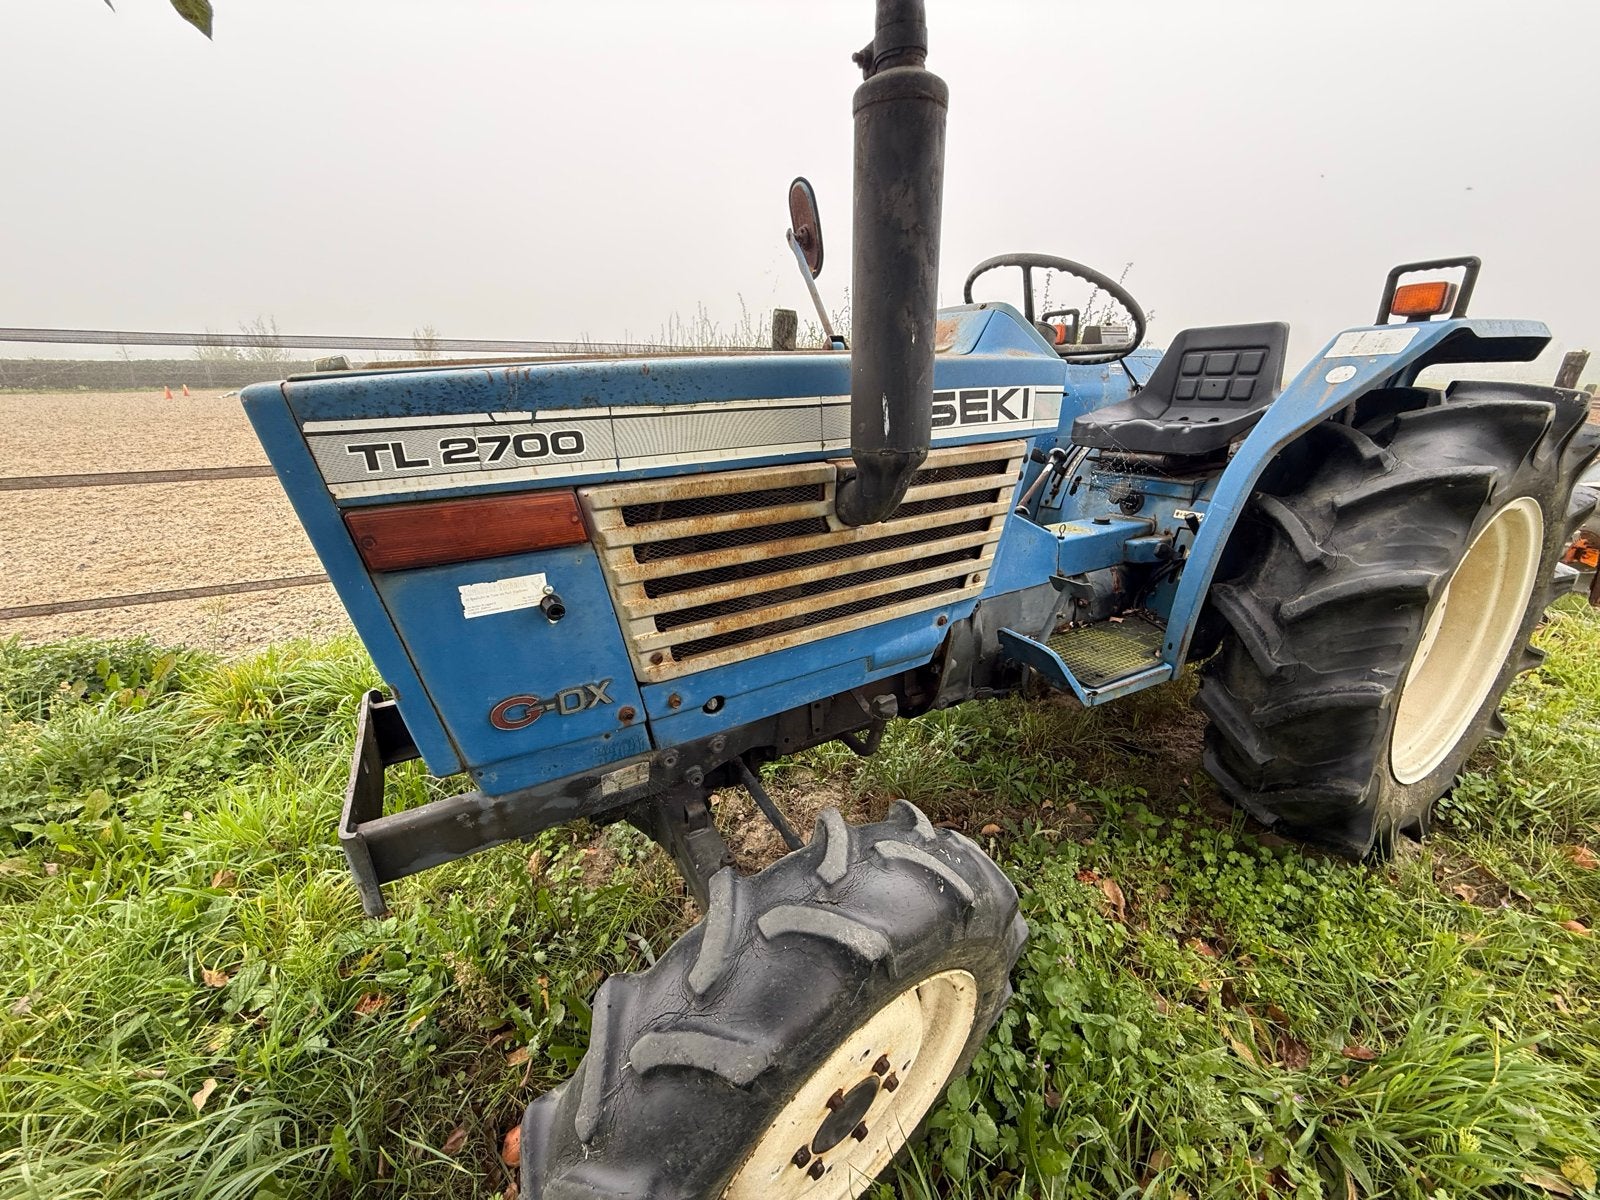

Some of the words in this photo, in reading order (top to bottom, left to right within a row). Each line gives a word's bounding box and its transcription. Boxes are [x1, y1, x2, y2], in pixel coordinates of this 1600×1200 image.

[931, 387, 1030, 427] SEKI
[346, 441, 431, 472] TL
[439, 429, 587, 466] 2700
[490, 678, 615, 731] G-DX
